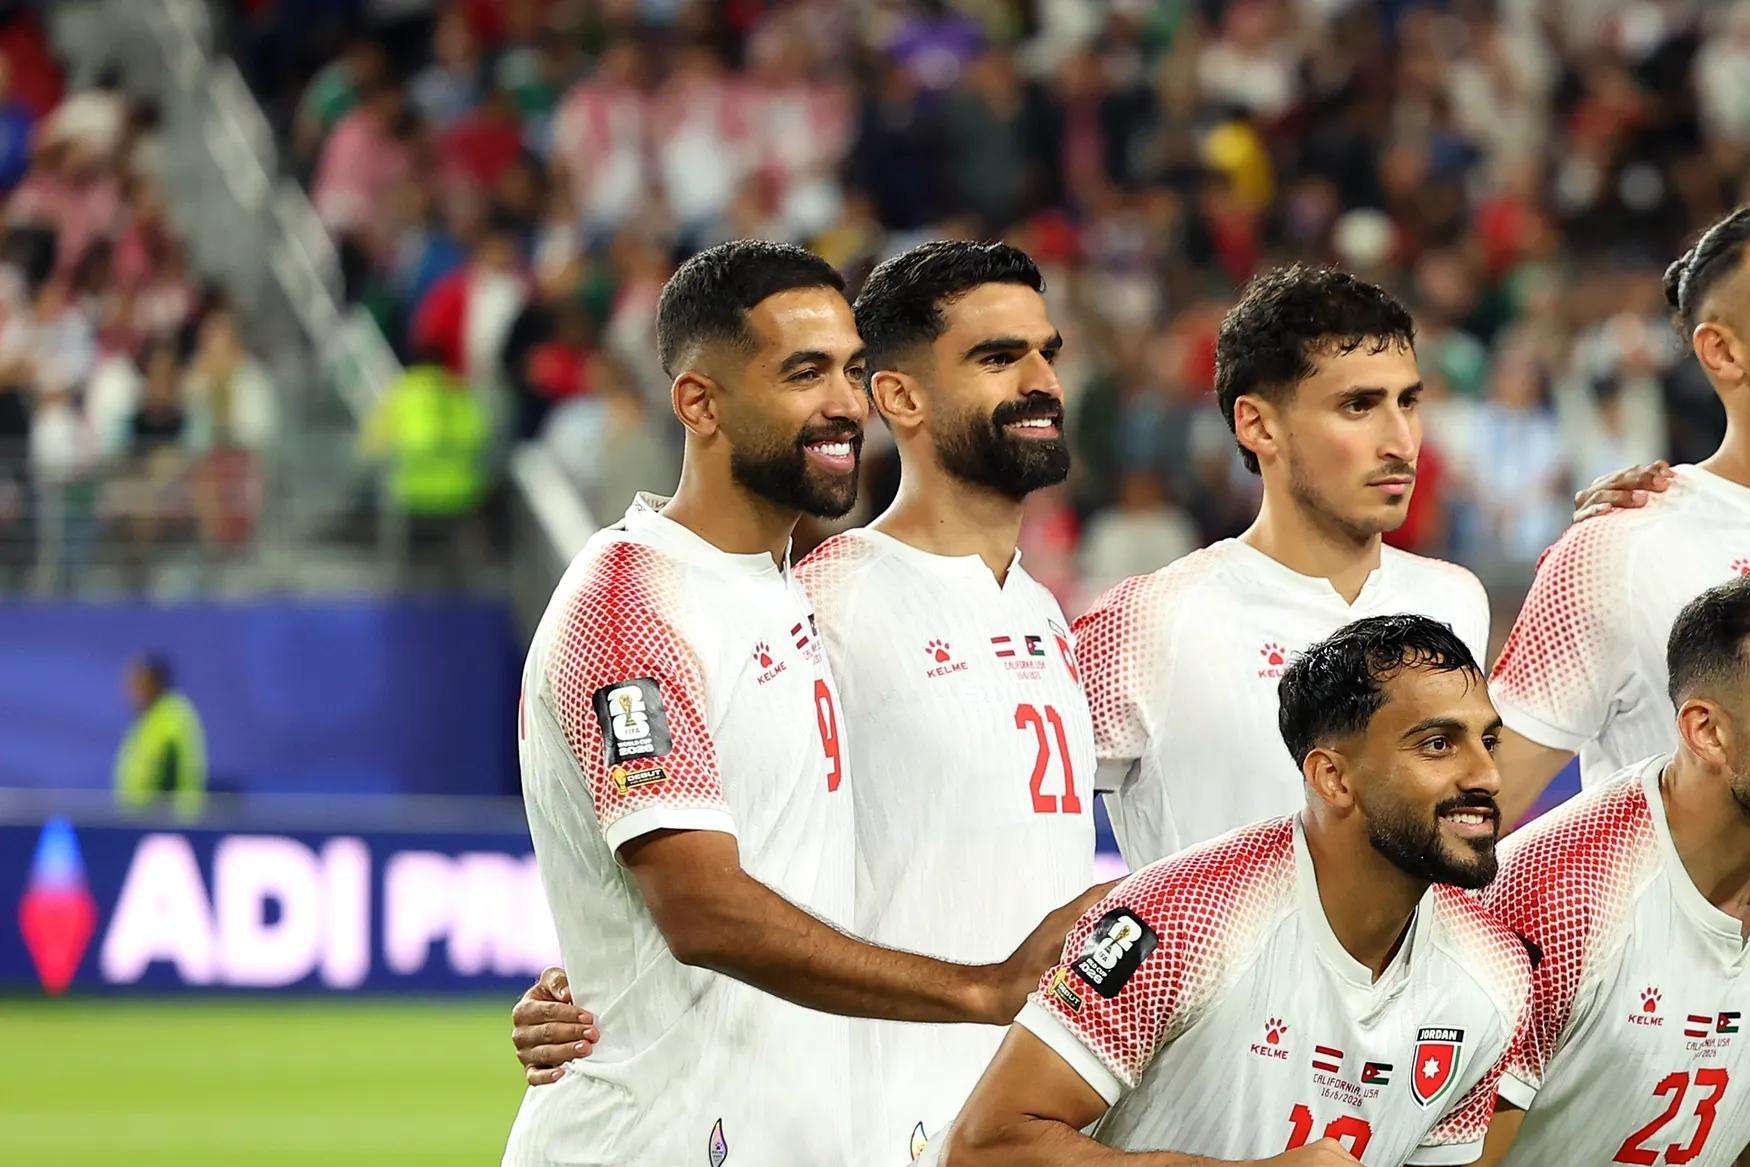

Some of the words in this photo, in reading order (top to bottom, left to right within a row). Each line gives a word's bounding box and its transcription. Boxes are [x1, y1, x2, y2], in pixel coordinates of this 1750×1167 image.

[757, 661, 787, 685] KELME
[927, 662, 968, 678] KELME
[814, 679, 841, 792] 9
[1014, 703, 1081, 814] 21
[627, 769, 661, 782] DEBUT
[100, 830, 371, 989] ADI
[1627, 1013, 1665, 1027] KELME
[1420, 1029, 1458, 1041] JORDAN
[1250, 1043, 1289, 1060] KELME
[1321, 1087, 1363, 1107] 16/6/2026
[1363, 1088, 1380, 1099] USA
[1612, 1068, 1730, 1166] 23
